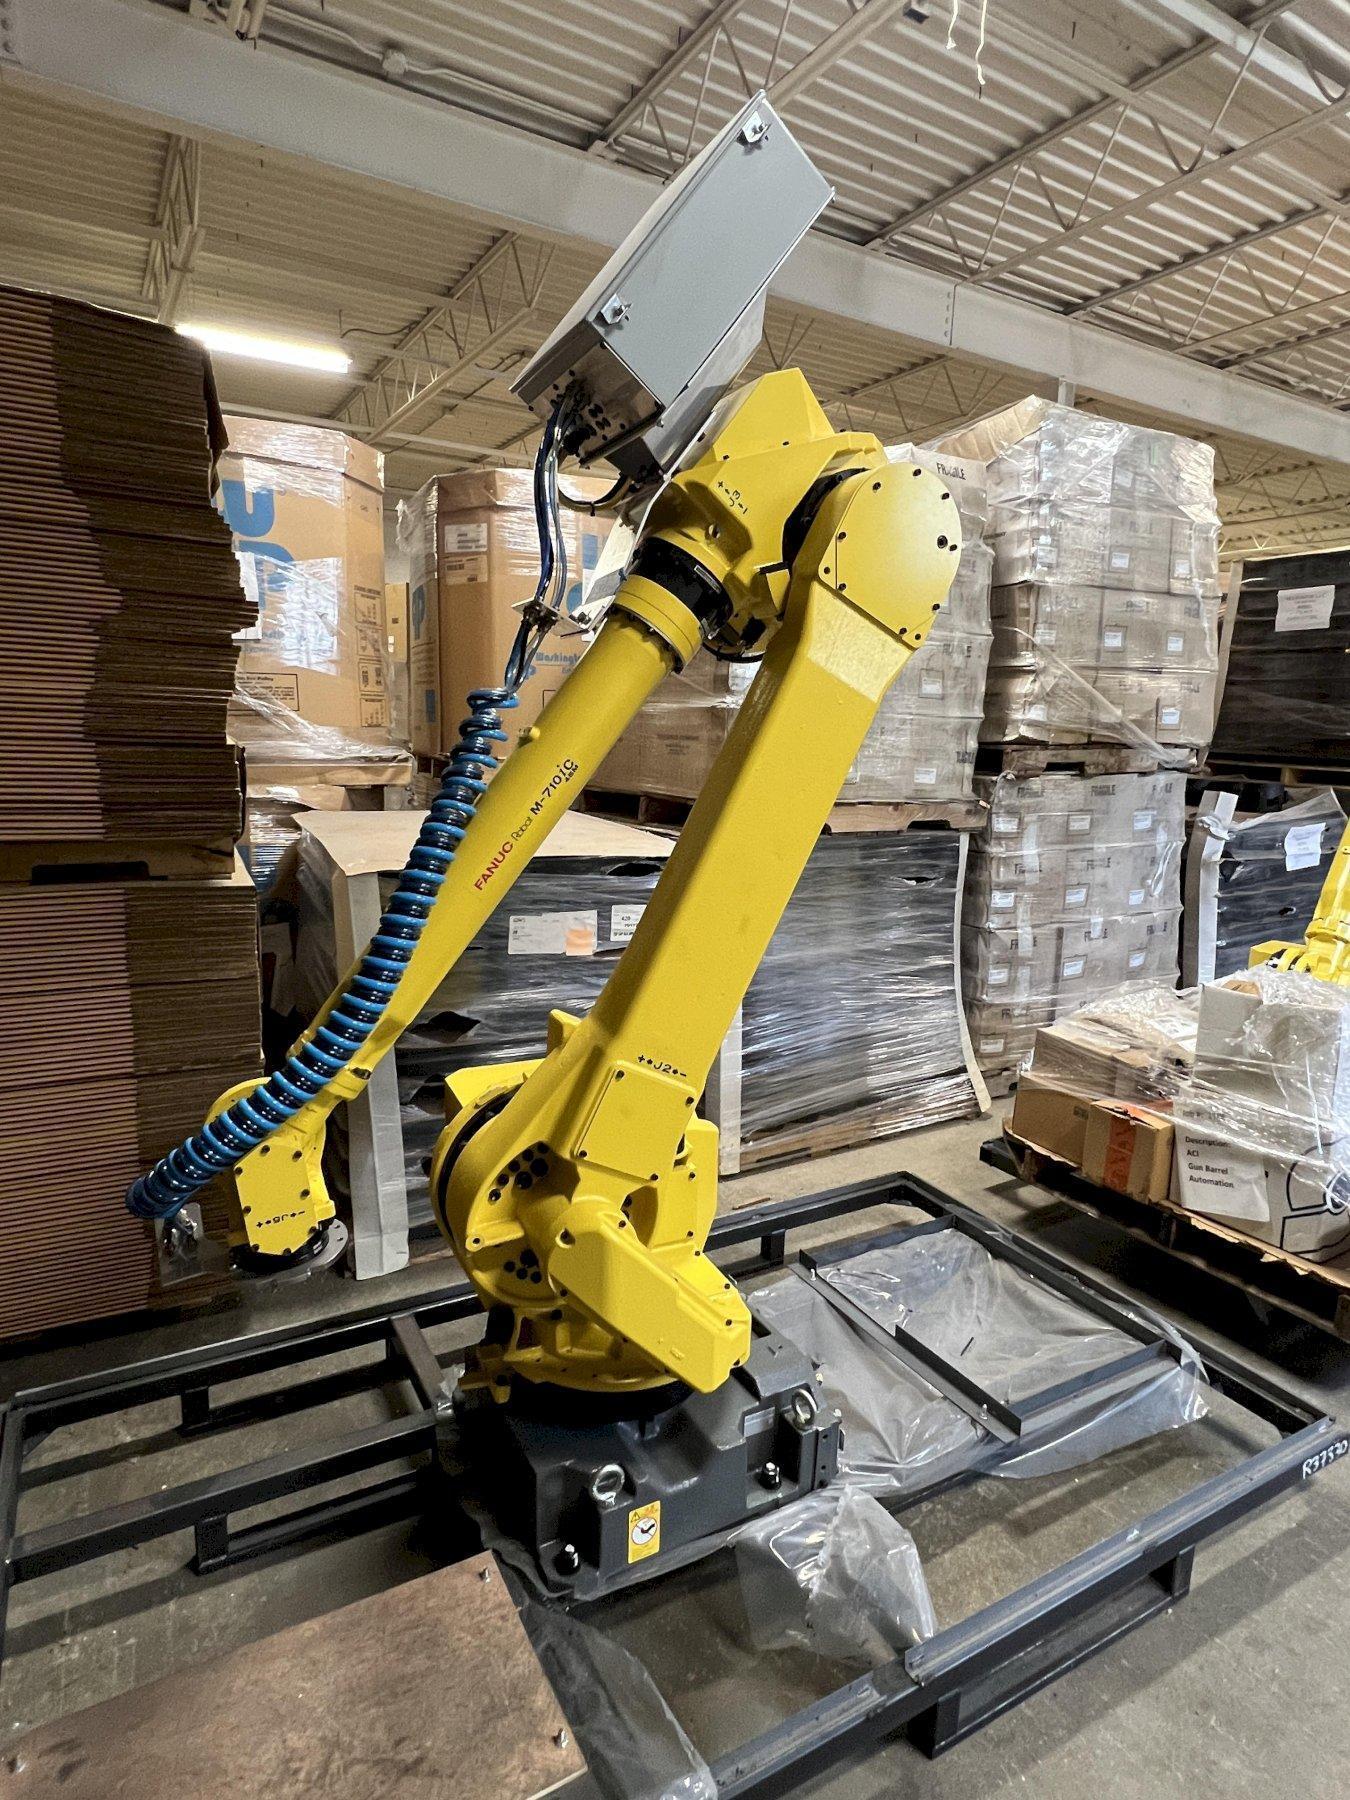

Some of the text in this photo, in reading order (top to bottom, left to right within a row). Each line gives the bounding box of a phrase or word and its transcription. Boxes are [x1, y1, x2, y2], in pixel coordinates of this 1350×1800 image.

[474, 841, 514, 891] FANUC
[511, 816, 533, 842] Robot
[1188, 1162, 1229, 1175] Gun Barrel
[1189, 1175, 1235, 1188] Automation
